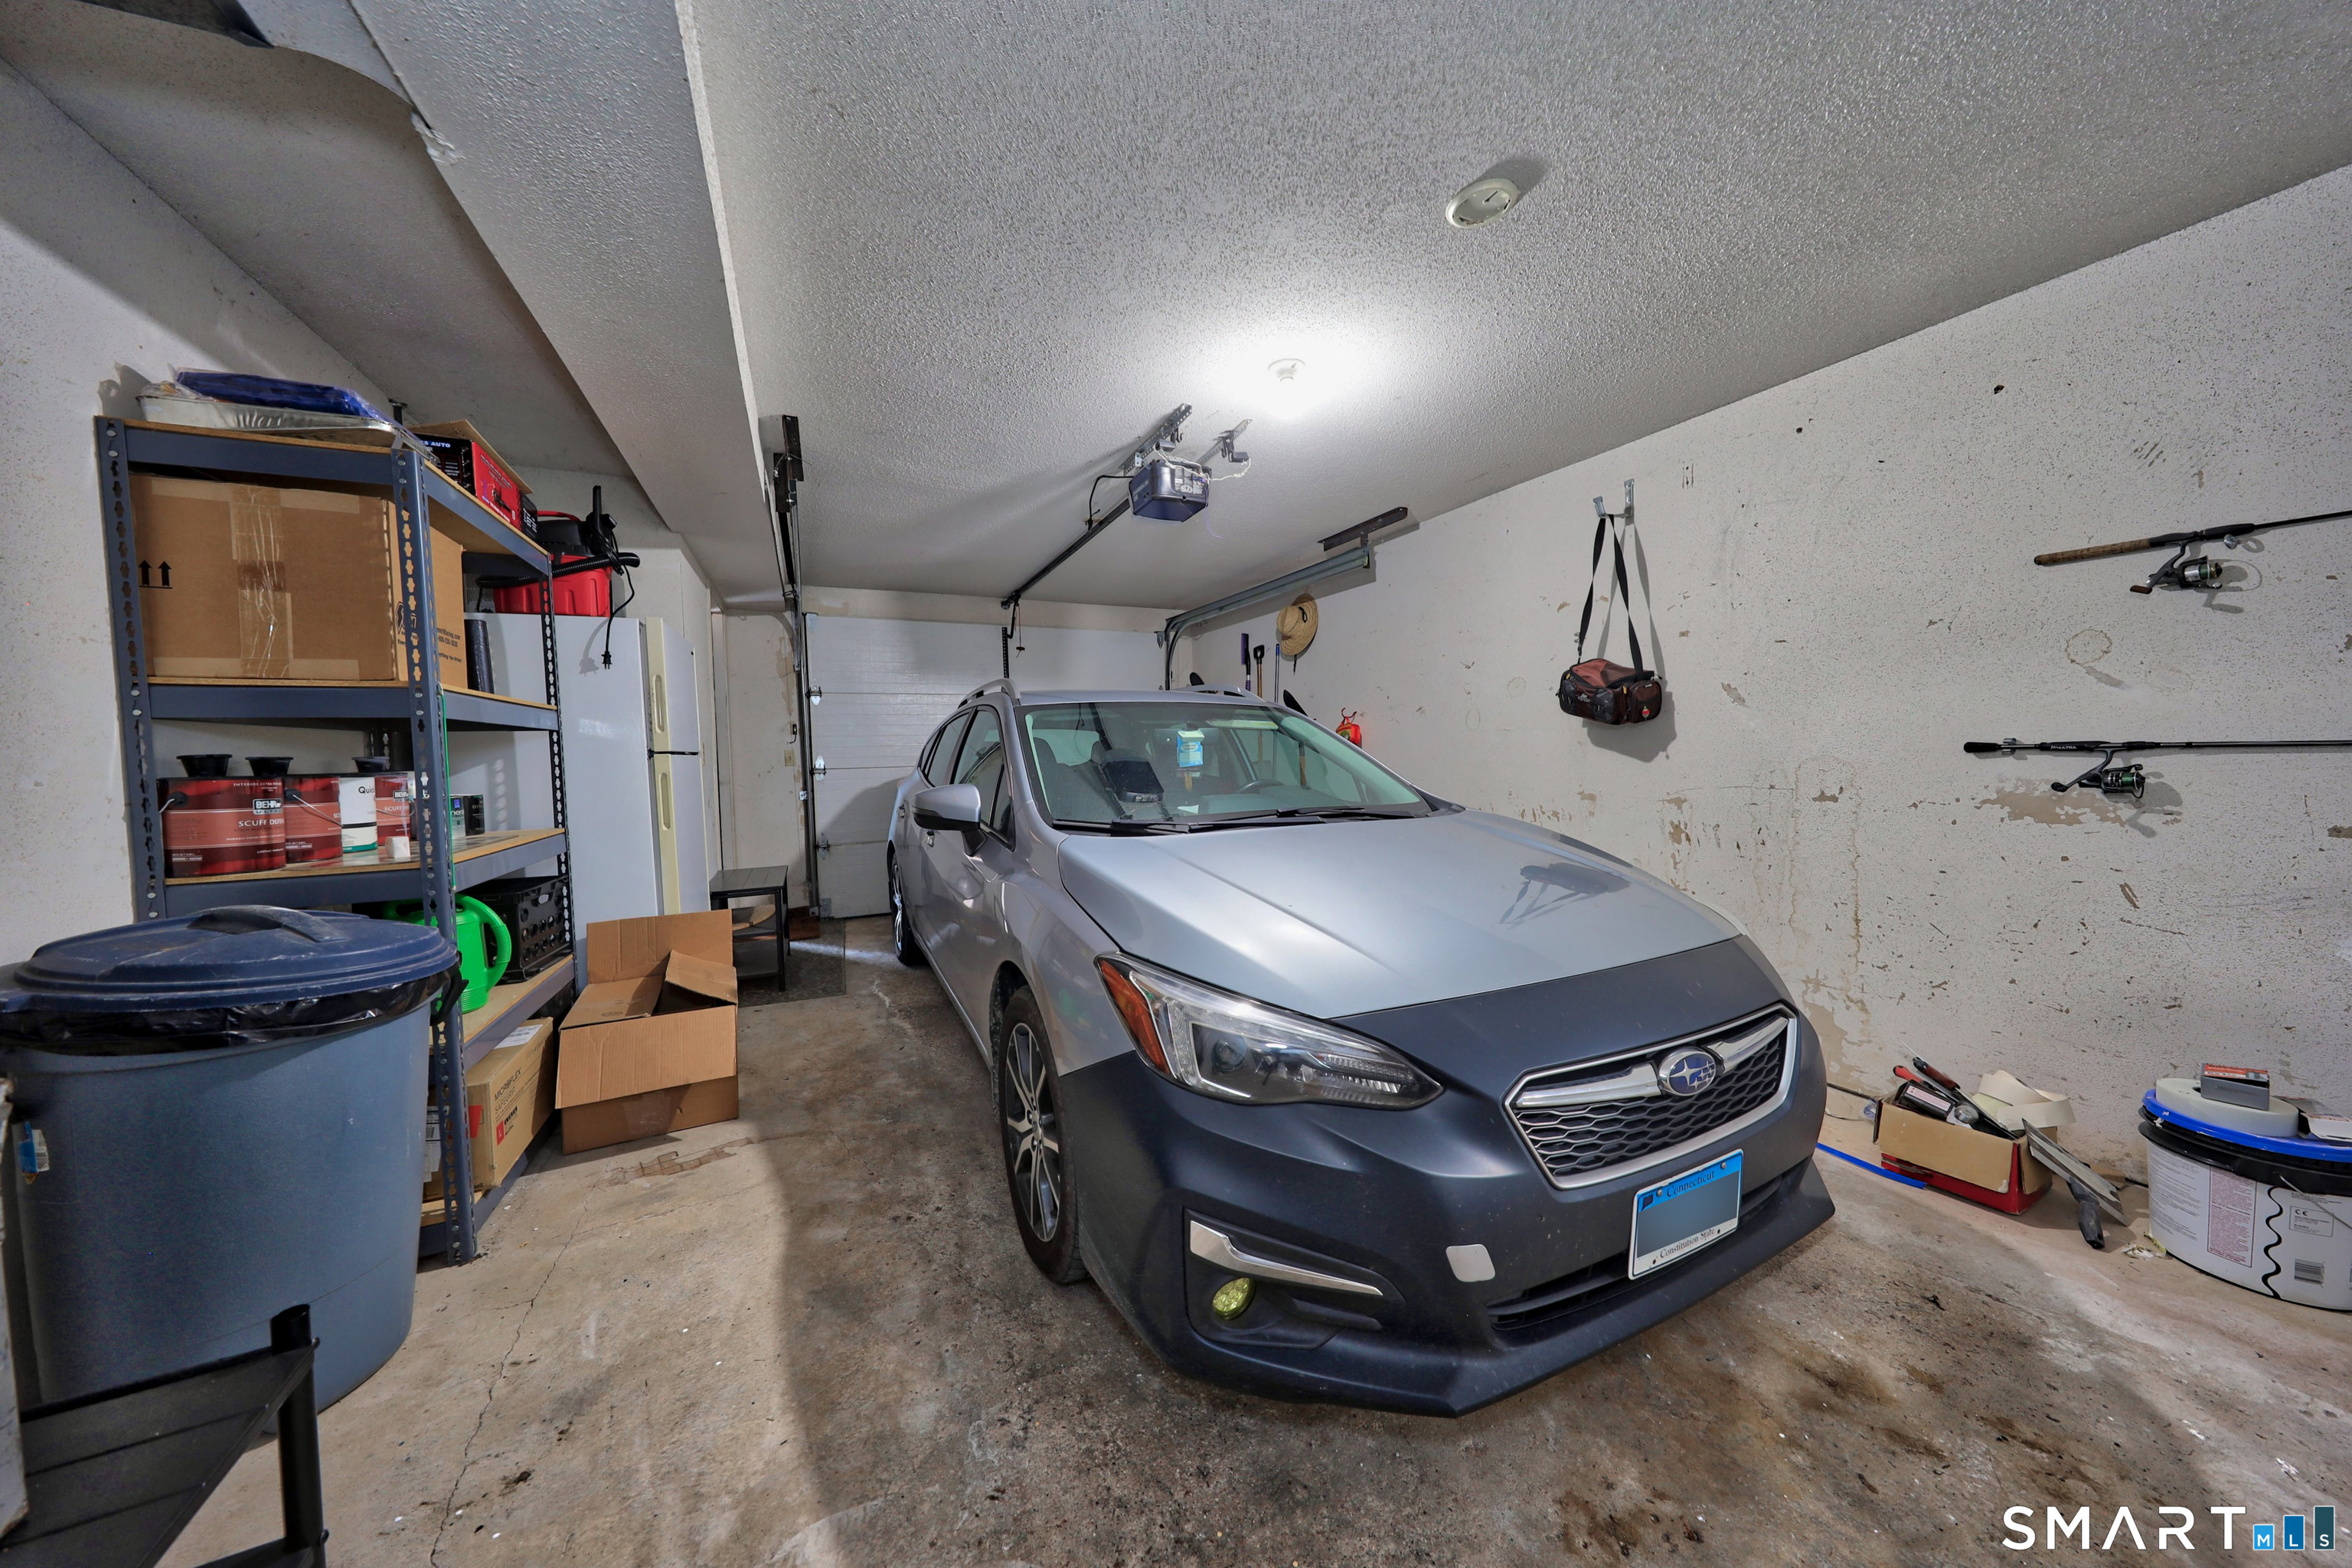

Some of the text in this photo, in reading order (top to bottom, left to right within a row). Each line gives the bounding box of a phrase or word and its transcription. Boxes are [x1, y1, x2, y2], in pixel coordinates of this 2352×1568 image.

[256, 800, 276, 809] BEHR
[238, 819, 267, 828] SCUFF
[495, 1086, 516, 1115] SAFEGRIP
[1667, 1171, 1714, 1197] Connecticut
[1660, 1227, 1715, 1259] Constitution State
